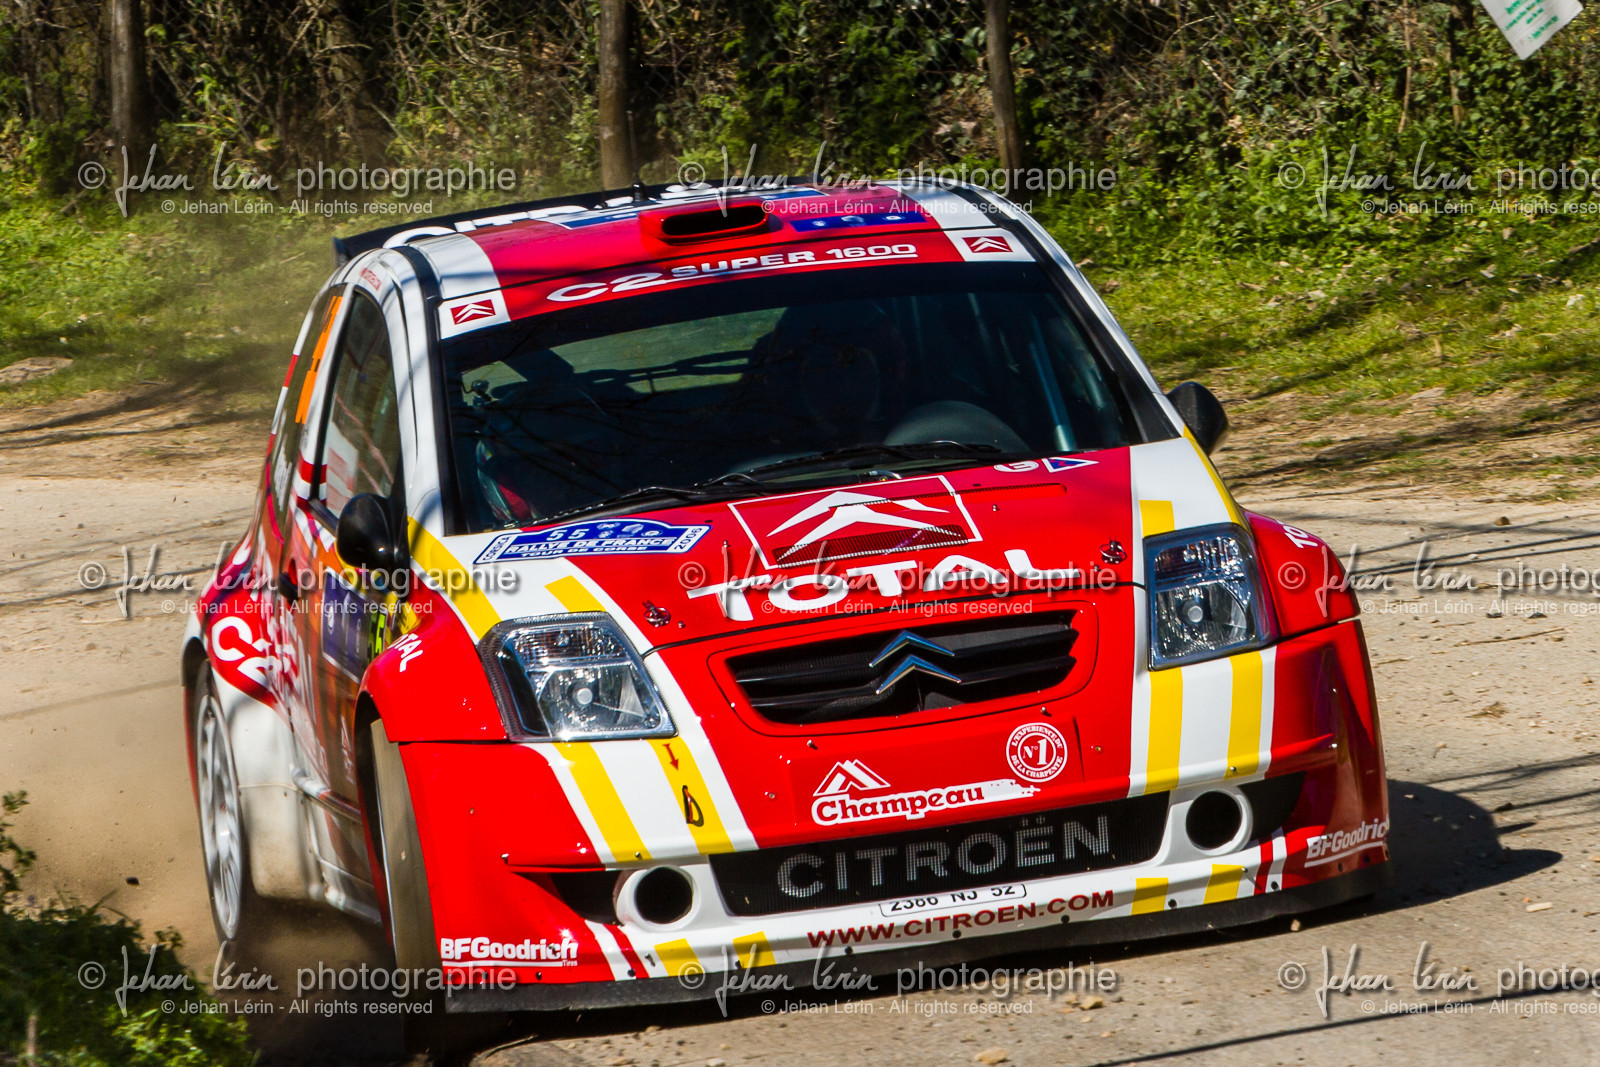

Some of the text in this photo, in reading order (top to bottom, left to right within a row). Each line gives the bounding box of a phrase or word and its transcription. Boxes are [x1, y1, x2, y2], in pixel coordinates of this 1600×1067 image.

[547, 243, 918, 302] C2 SUPER 1600
[504, 541, 569, 554] RALLYE
[600, 537, 677, 547] FRANCE
[686, 549, 1080, 622] TOTAL
[816, 786, 985, 821] Champeau
[777, 814, 1110, 898] CITROËN
[440, 936, 579, 960] BFGoodrich
[807, 889, 1114, 948] WWW.CITROEN.COM
